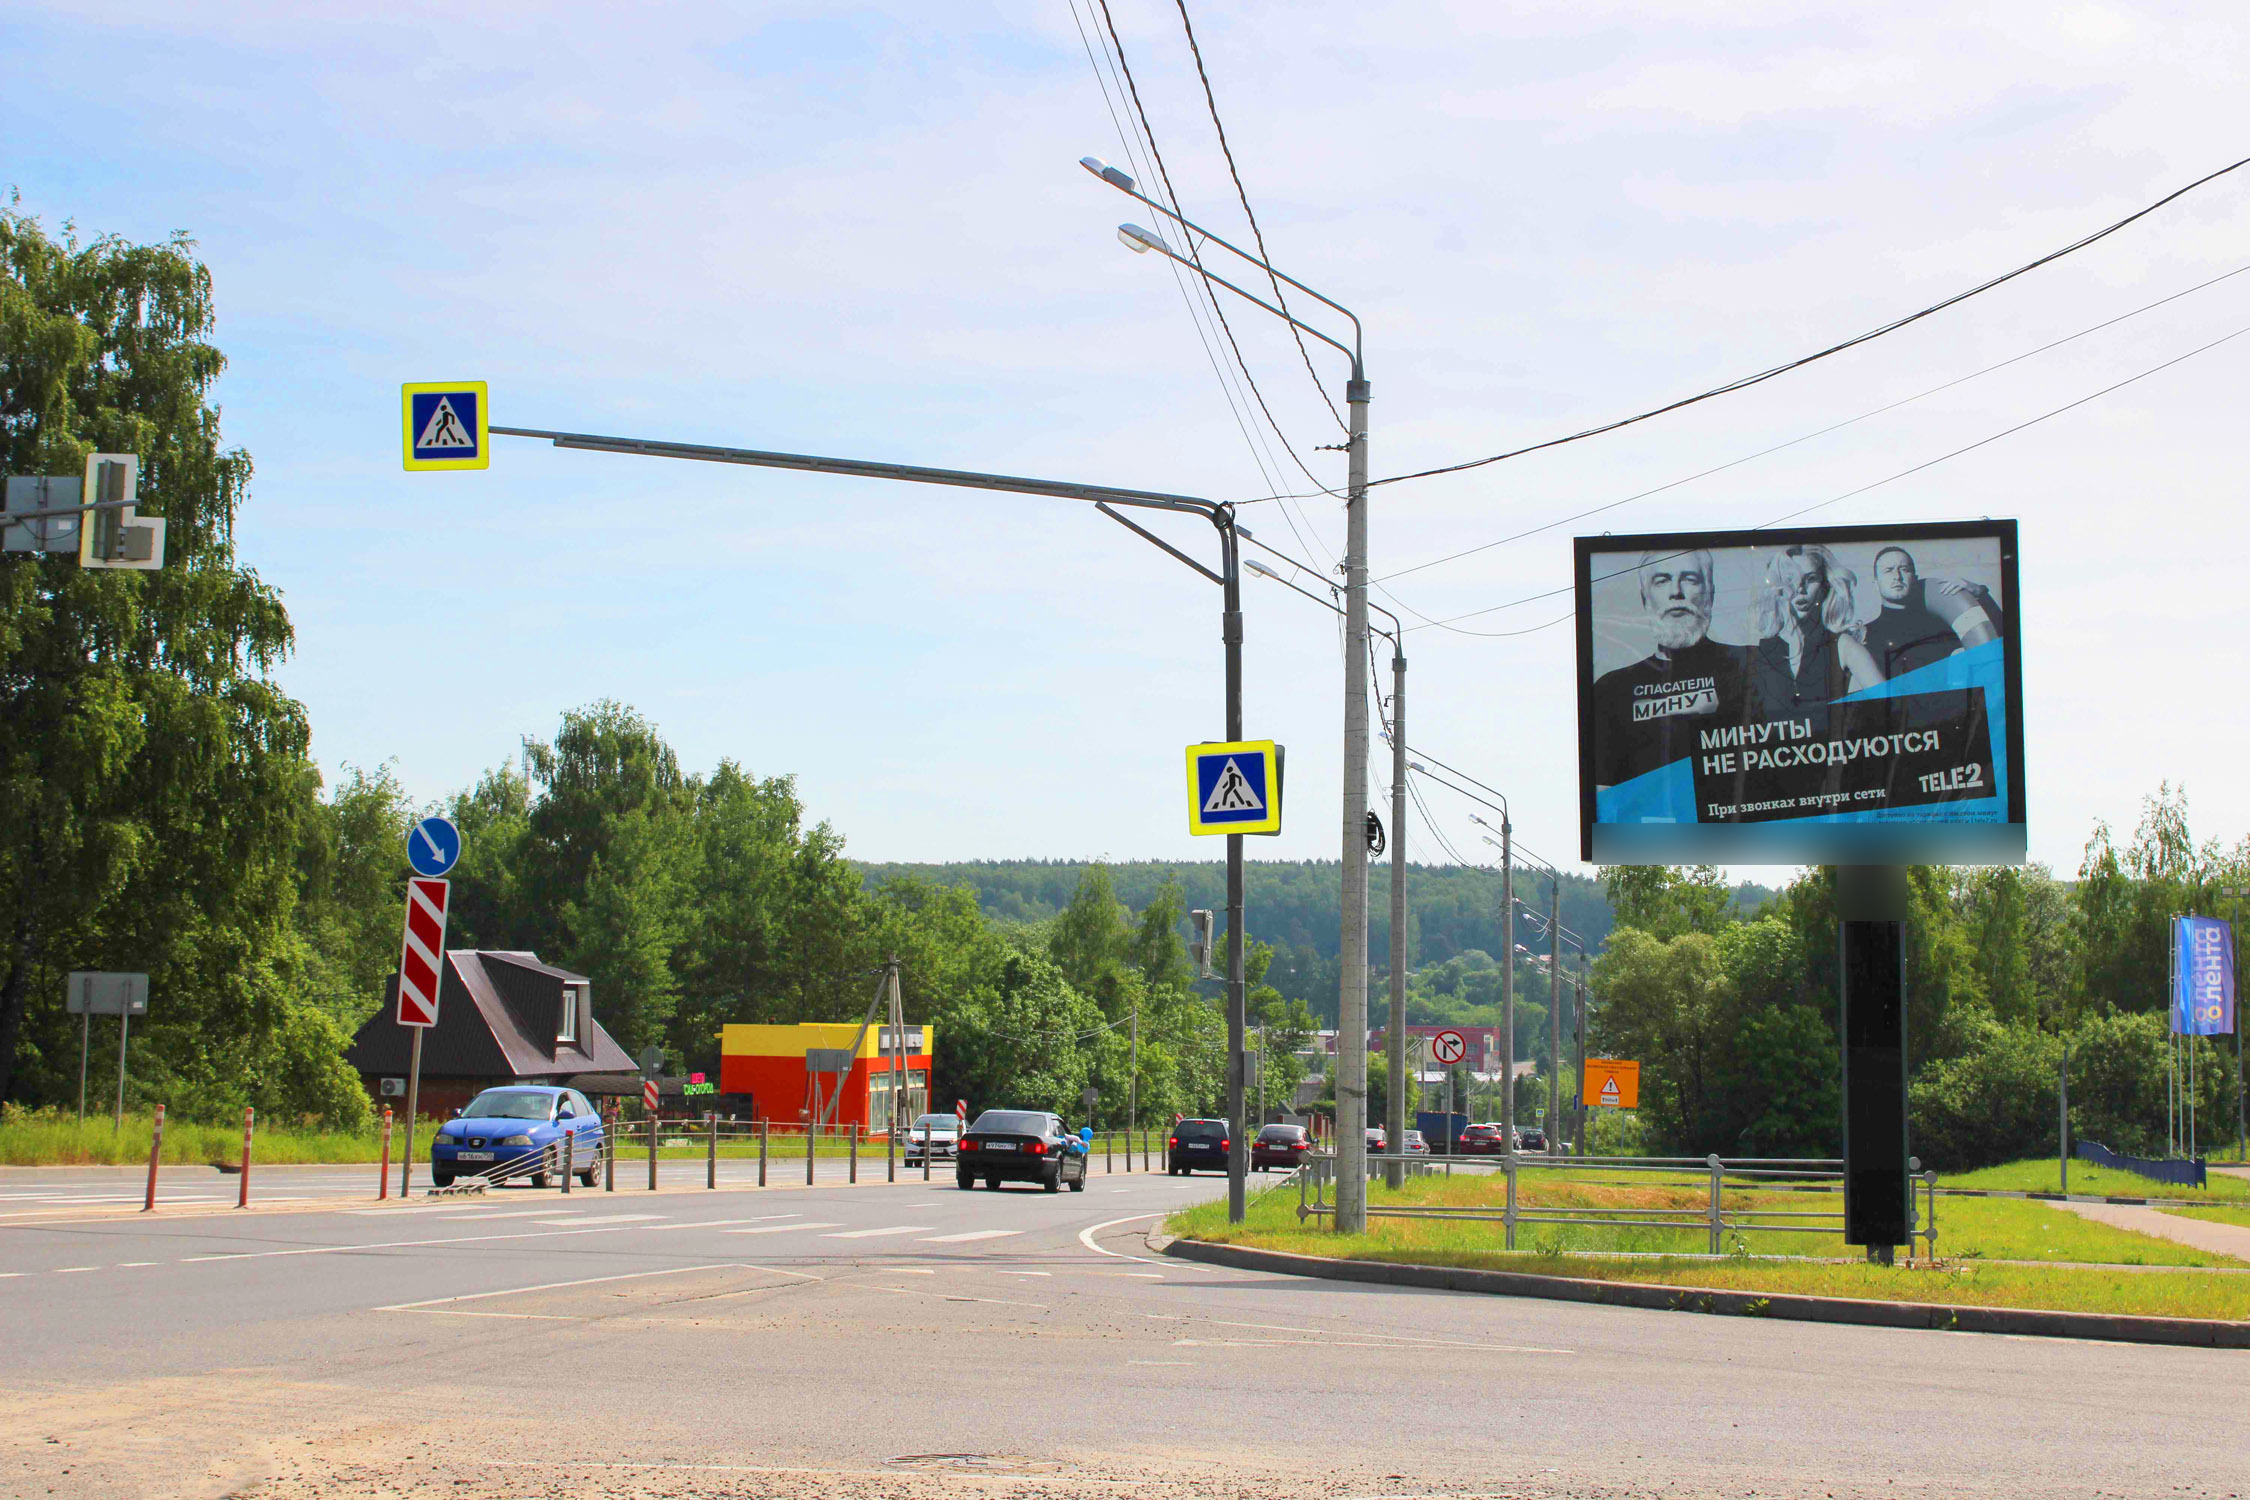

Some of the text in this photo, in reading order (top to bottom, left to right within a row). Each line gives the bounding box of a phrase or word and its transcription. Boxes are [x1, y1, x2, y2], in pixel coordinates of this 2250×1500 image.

[1633, 676, 1715, 696] СПАСАТЕЛИ
[1634, 690, 1715, 719] МИНУТ
[1700, 718, 1812, 750] МИНУТЫ
[1703, 730, 1940, 776] НЕ РАСХОДУЮТСЯ
[1918, 762, 1984, 793] TELE2
[1708, 788, 1886, 818] При звонках внутри сети
[2206, 927, 2222, 1002] лента
